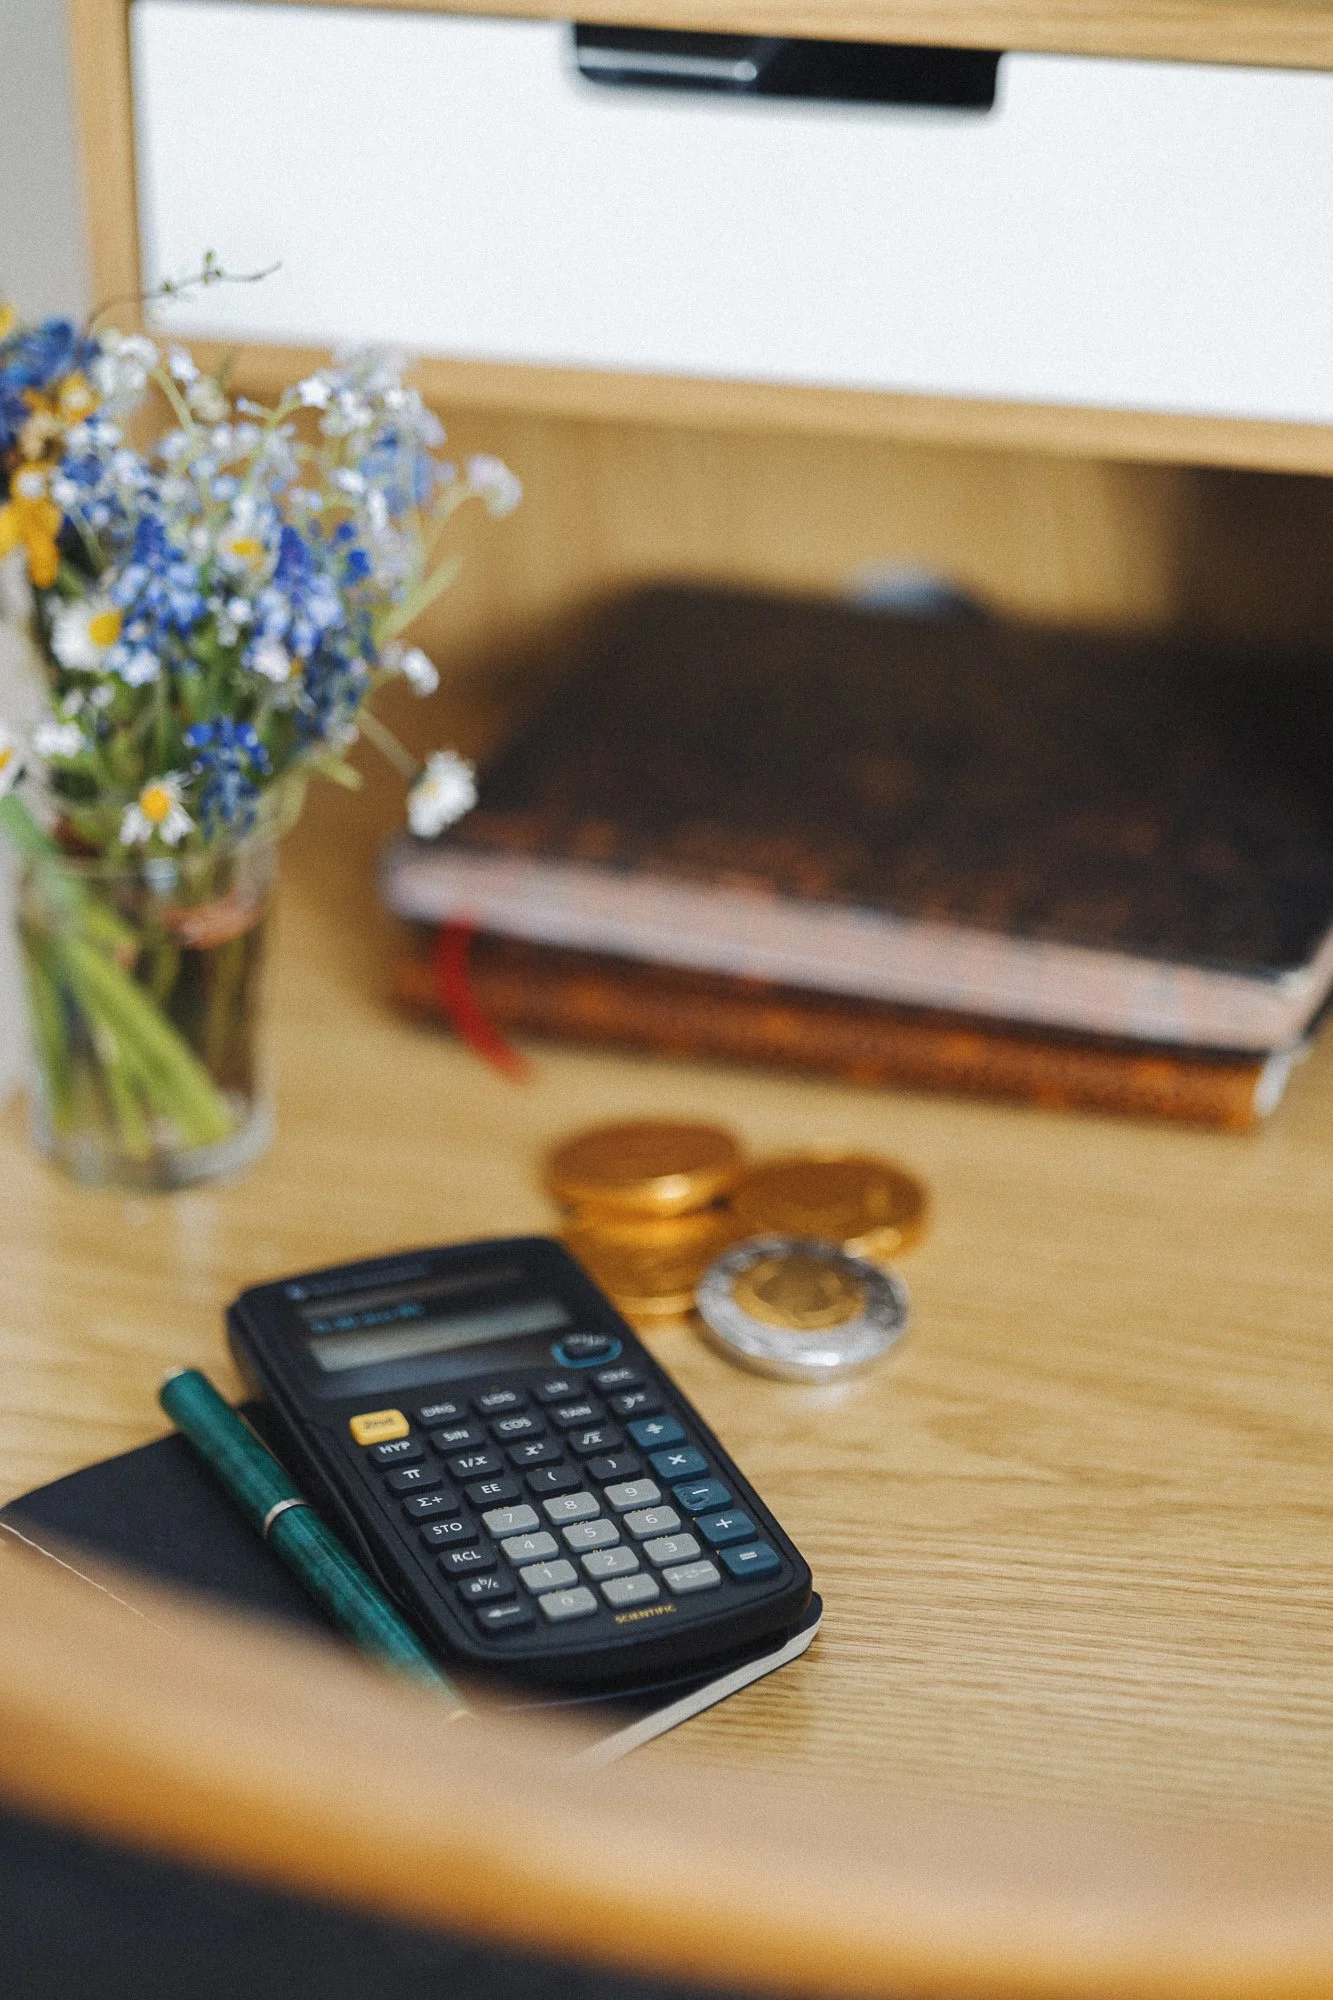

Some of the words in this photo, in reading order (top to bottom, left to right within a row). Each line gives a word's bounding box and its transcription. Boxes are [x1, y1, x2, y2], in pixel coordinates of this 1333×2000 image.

[481, 1391, 516, 1405] LOG
[560, 1406, 592, 1419] TAN
[499, 1417, 532, 1430] COS
[442, 1430, 469, 1441] SIN
[378, 1441, 411, 1454] HYP
[481, 1483, 502, 1494] EE
[625, 1487, 638, 1497] 9
[564, 1500, 577, 1510] 8
[502, 1513, 513, 1523] 7
[645, 1514, 658, 1524] 6
[432, 1522, 463, 1535] STO
[584, 1527, 597, 1538] 5
[524, 1540, 535, 1549] 4
[664, 1542, 678, 1552] 3
[452, 1551, 481, 1563] RCL
[604, 1555, 617, 1566] 2
[543, 1568, 552, 1578] 1
[561, 1596, 573, 1607] 0
[615, 1603, 678, 1624] SCIENTIFIC
